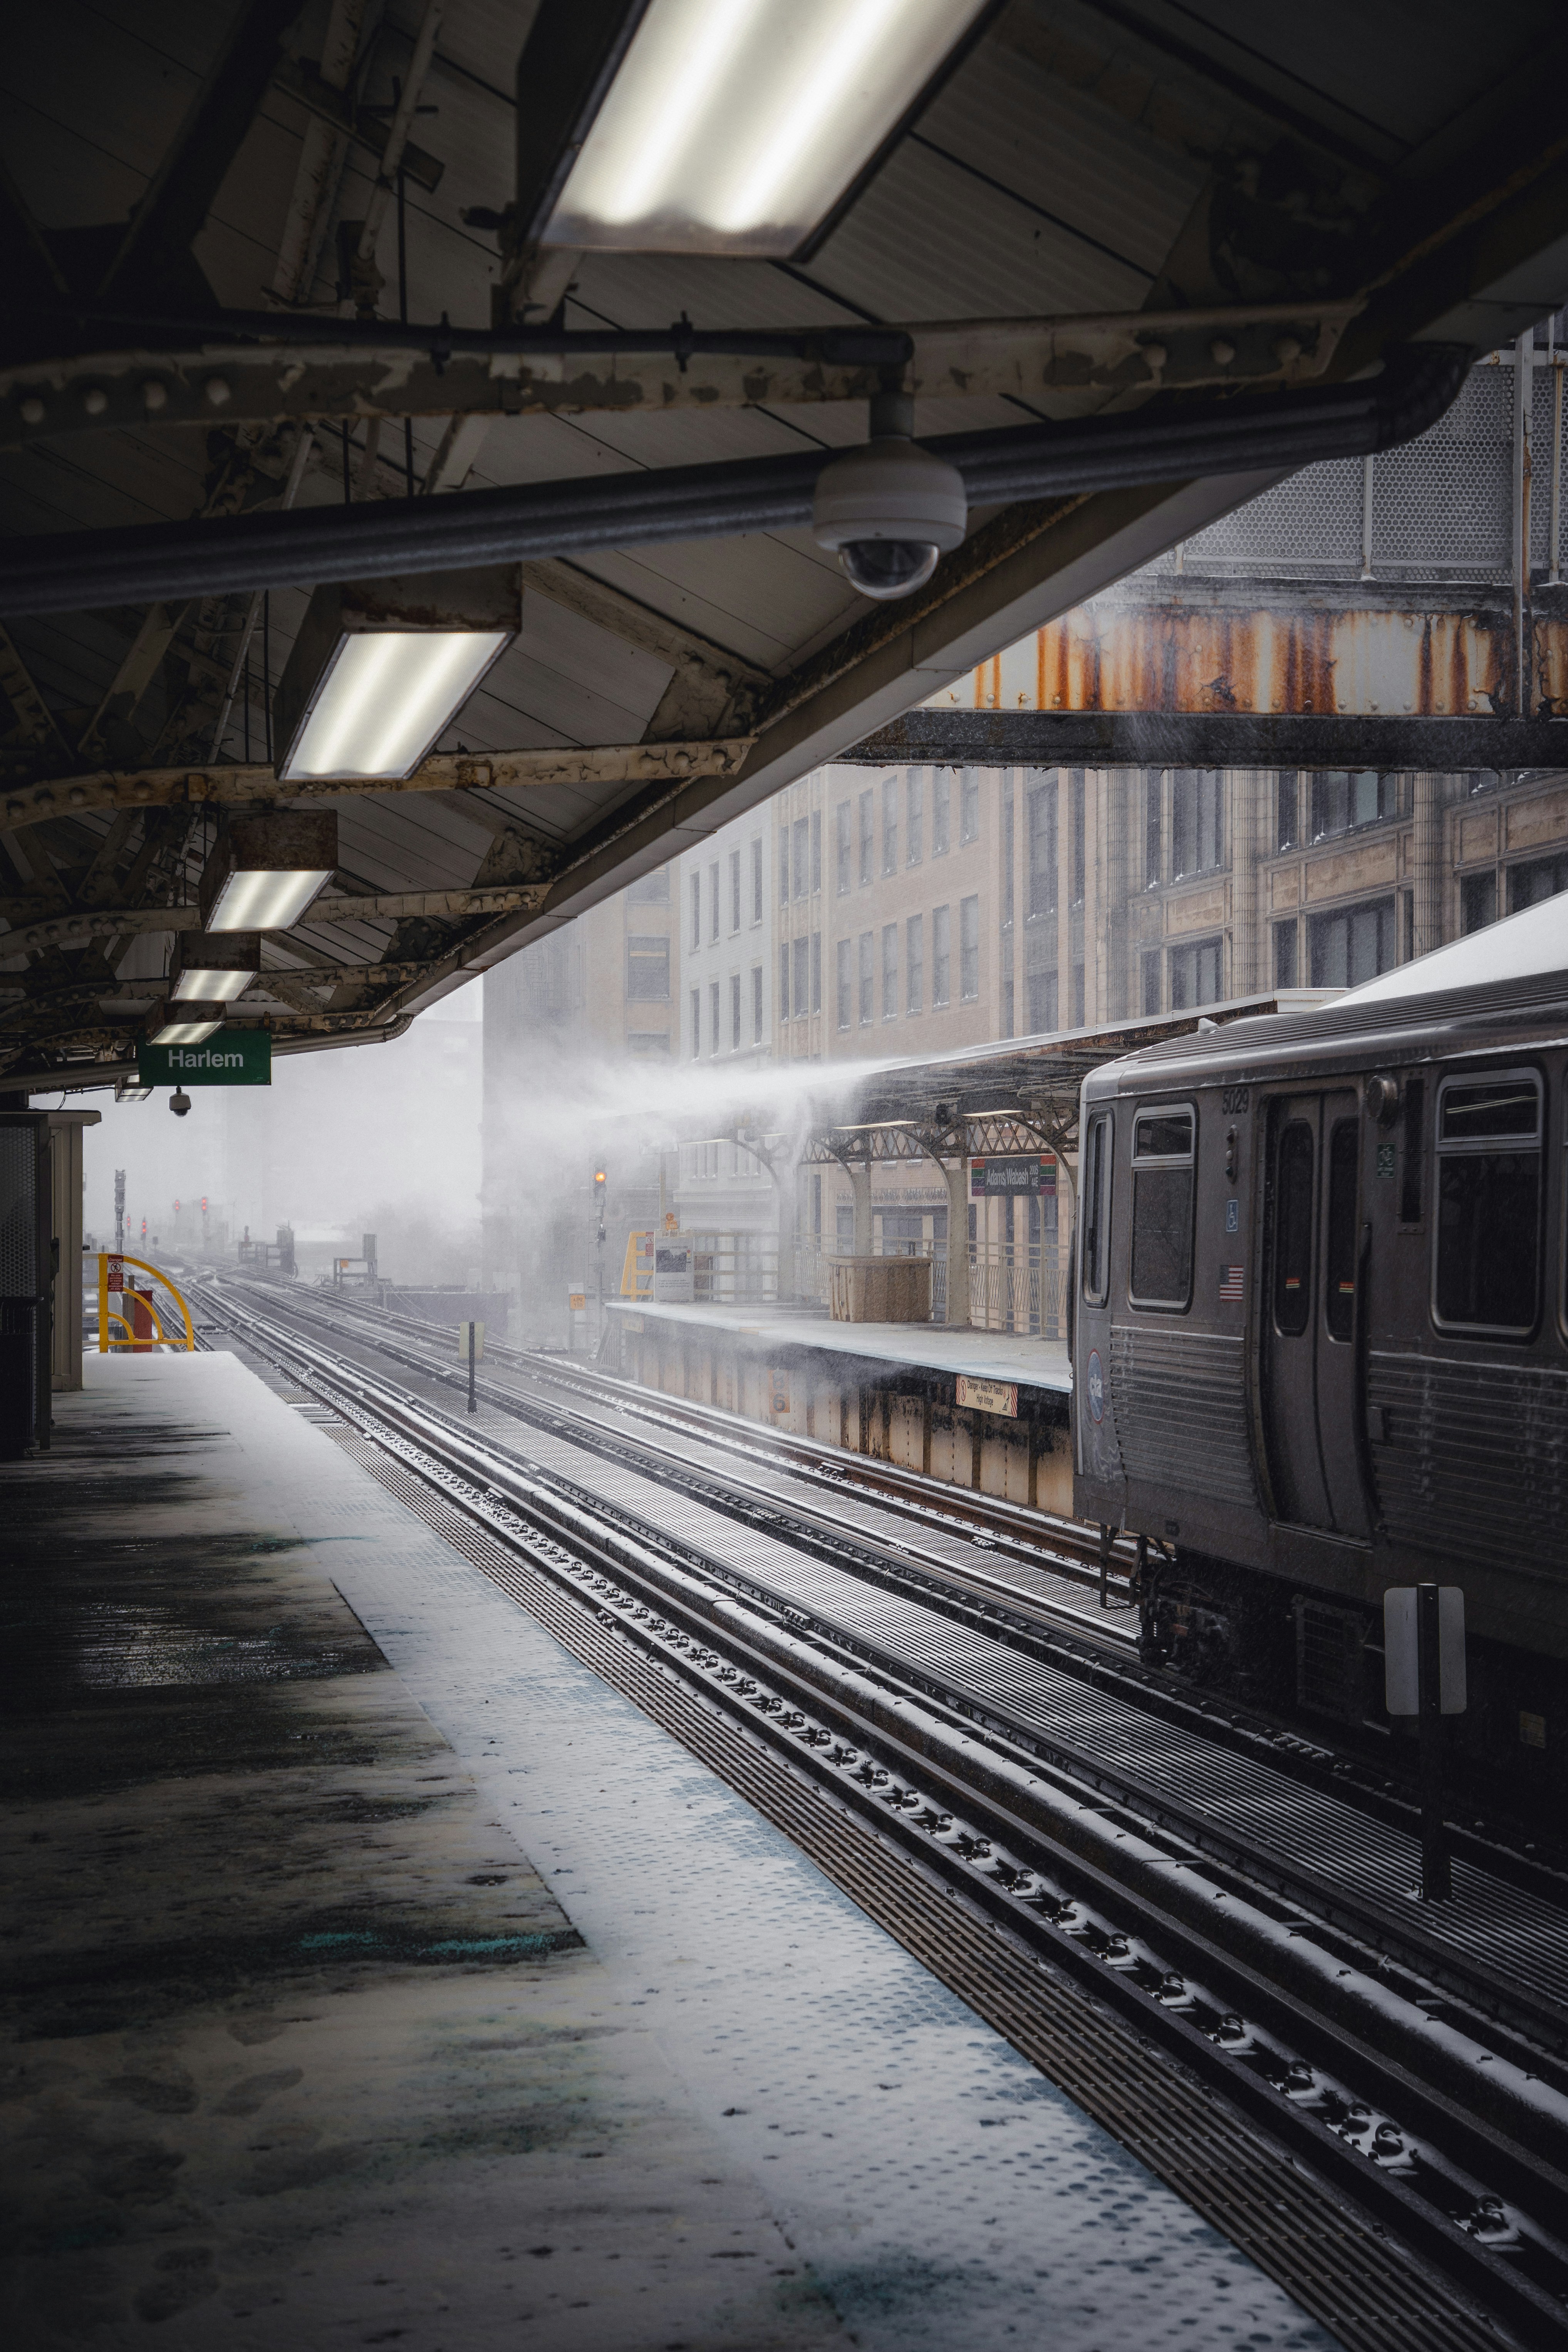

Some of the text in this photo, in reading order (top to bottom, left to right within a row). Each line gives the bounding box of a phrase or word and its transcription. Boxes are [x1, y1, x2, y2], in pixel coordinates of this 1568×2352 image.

[168, 1050, 243, 1067] Harlem
[1222, 1088, 1249, 1115] 5029
[987, 1168, 1029, 1186] Adams/Wabash
[1030, 1164, 1038, 1175] 200S
[968, 1380, 978, 1392] Danger
[993, 1385, 1003, 1396] Tracks
[773, 1393, 785, 1412] 6
[984, 1395, 994, 1408] Voltage
